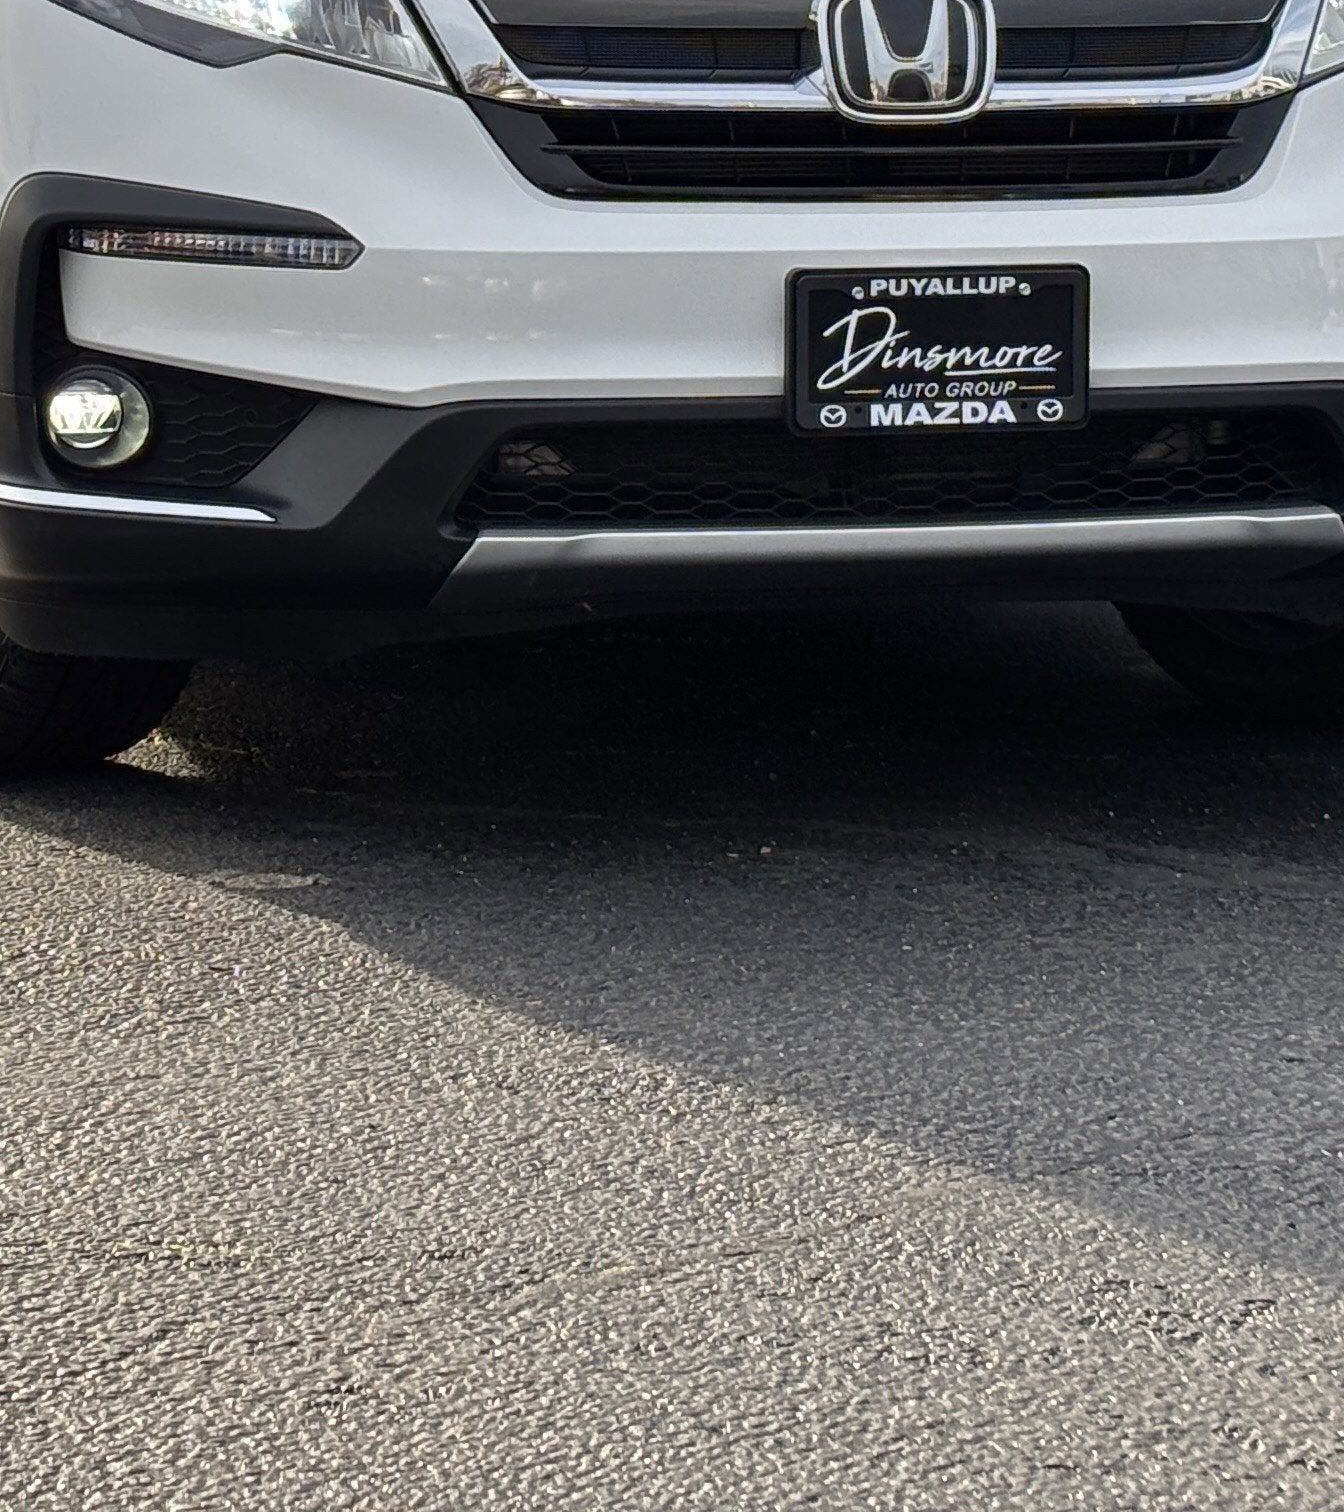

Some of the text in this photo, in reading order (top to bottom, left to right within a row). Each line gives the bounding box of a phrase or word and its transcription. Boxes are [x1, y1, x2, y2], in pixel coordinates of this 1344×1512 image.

[869, 276, 1017, 298] PUYALLUP
[816, 305, 1063, 390] Dinsmore
[884, 380, 1017, 399] AUTO GROUP
[869, 400, 1018, 427] MAZDA
